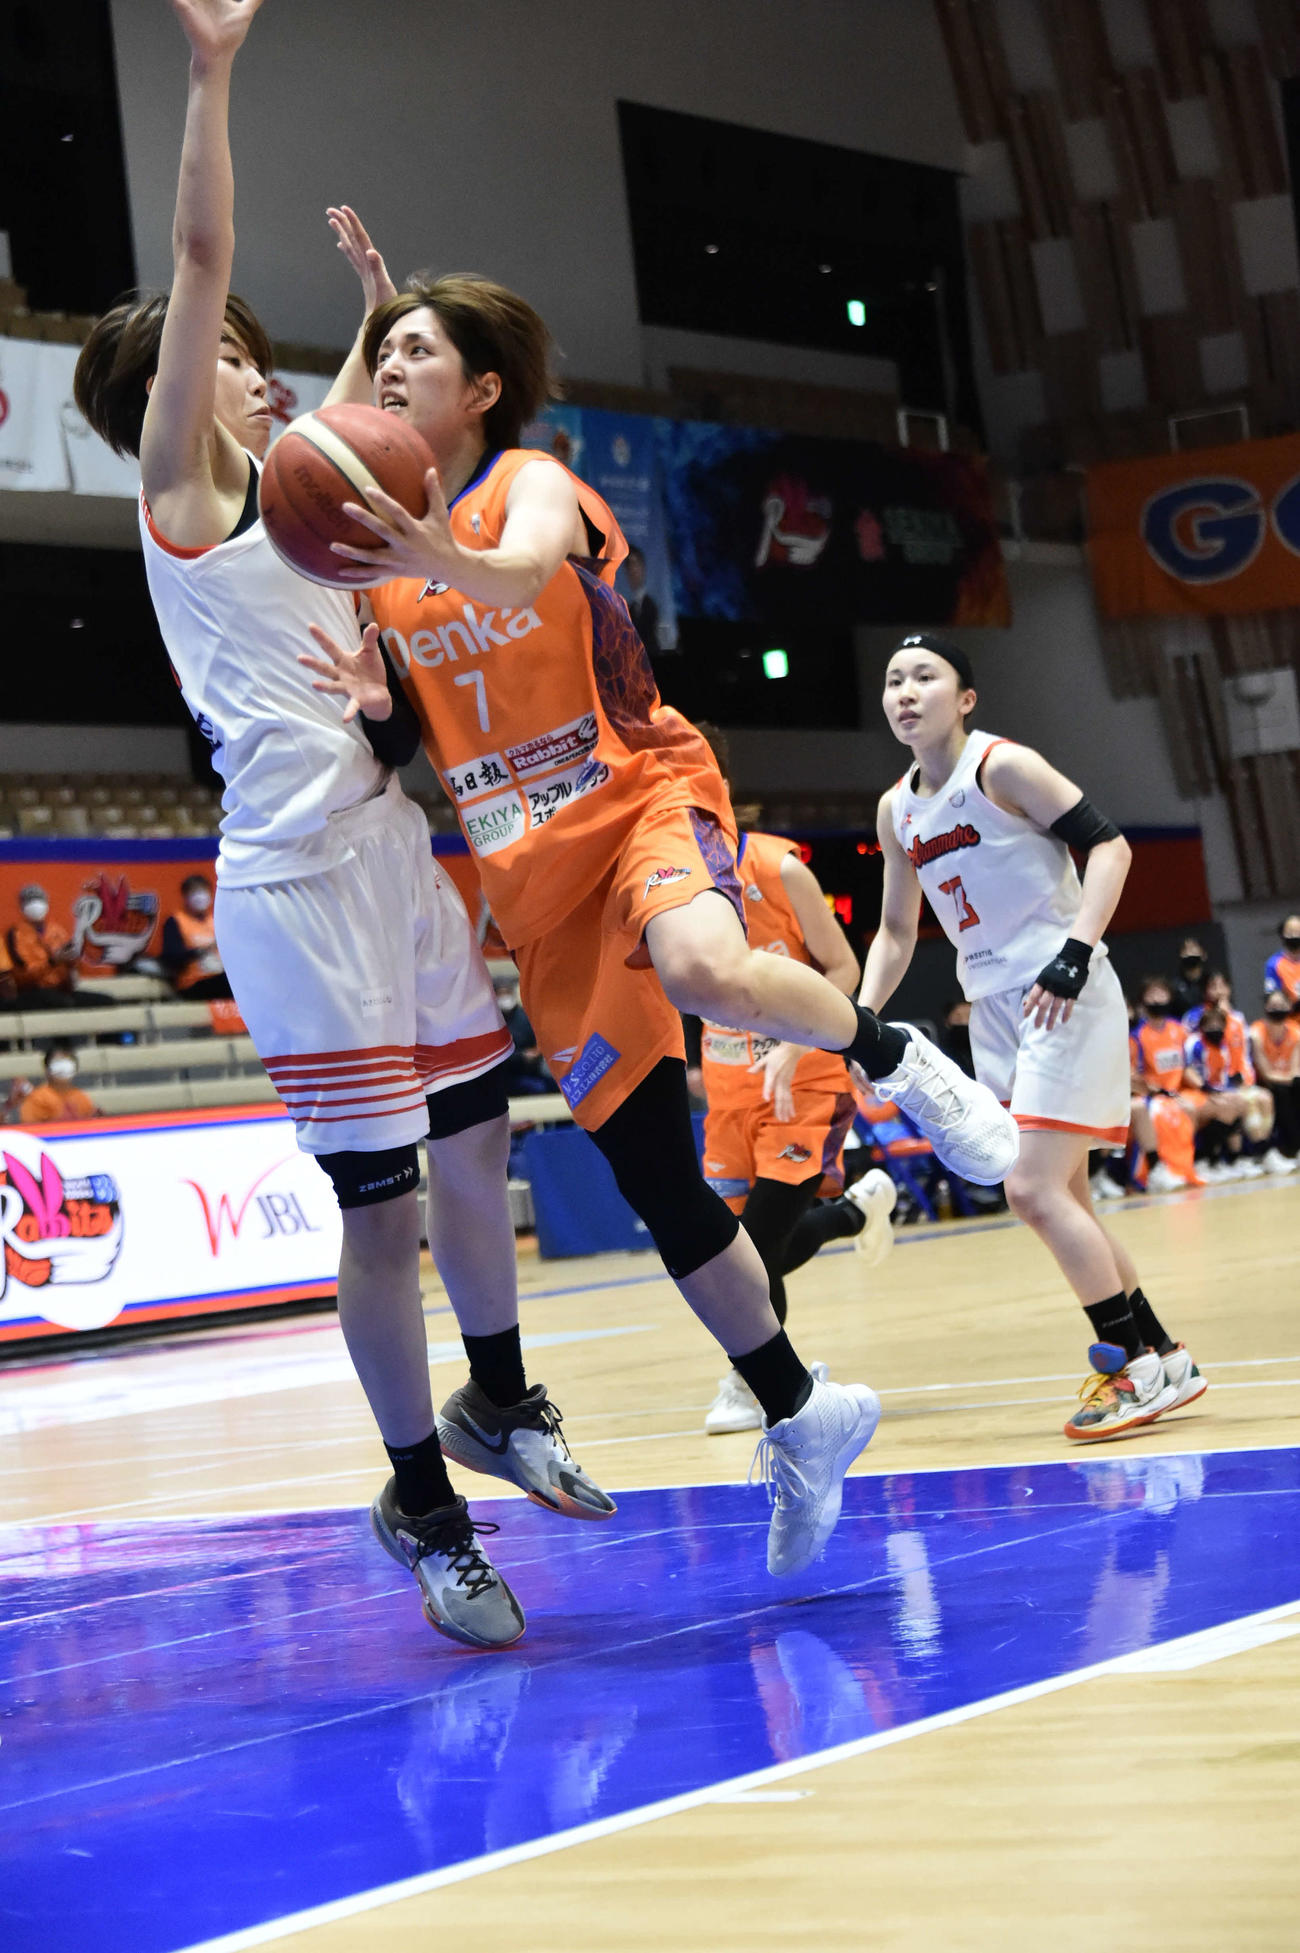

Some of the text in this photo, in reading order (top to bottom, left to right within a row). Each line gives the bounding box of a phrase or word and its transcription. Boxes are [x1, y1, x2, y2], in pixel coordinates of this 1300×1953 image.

[1139, 476, 1300, 586] G
[453, 669, 491, 733] 7
[513, 736, 577, 769] Rabbit
[528, 781, 573, 811] アップル
[474, 824, 515, 847] GROUP
